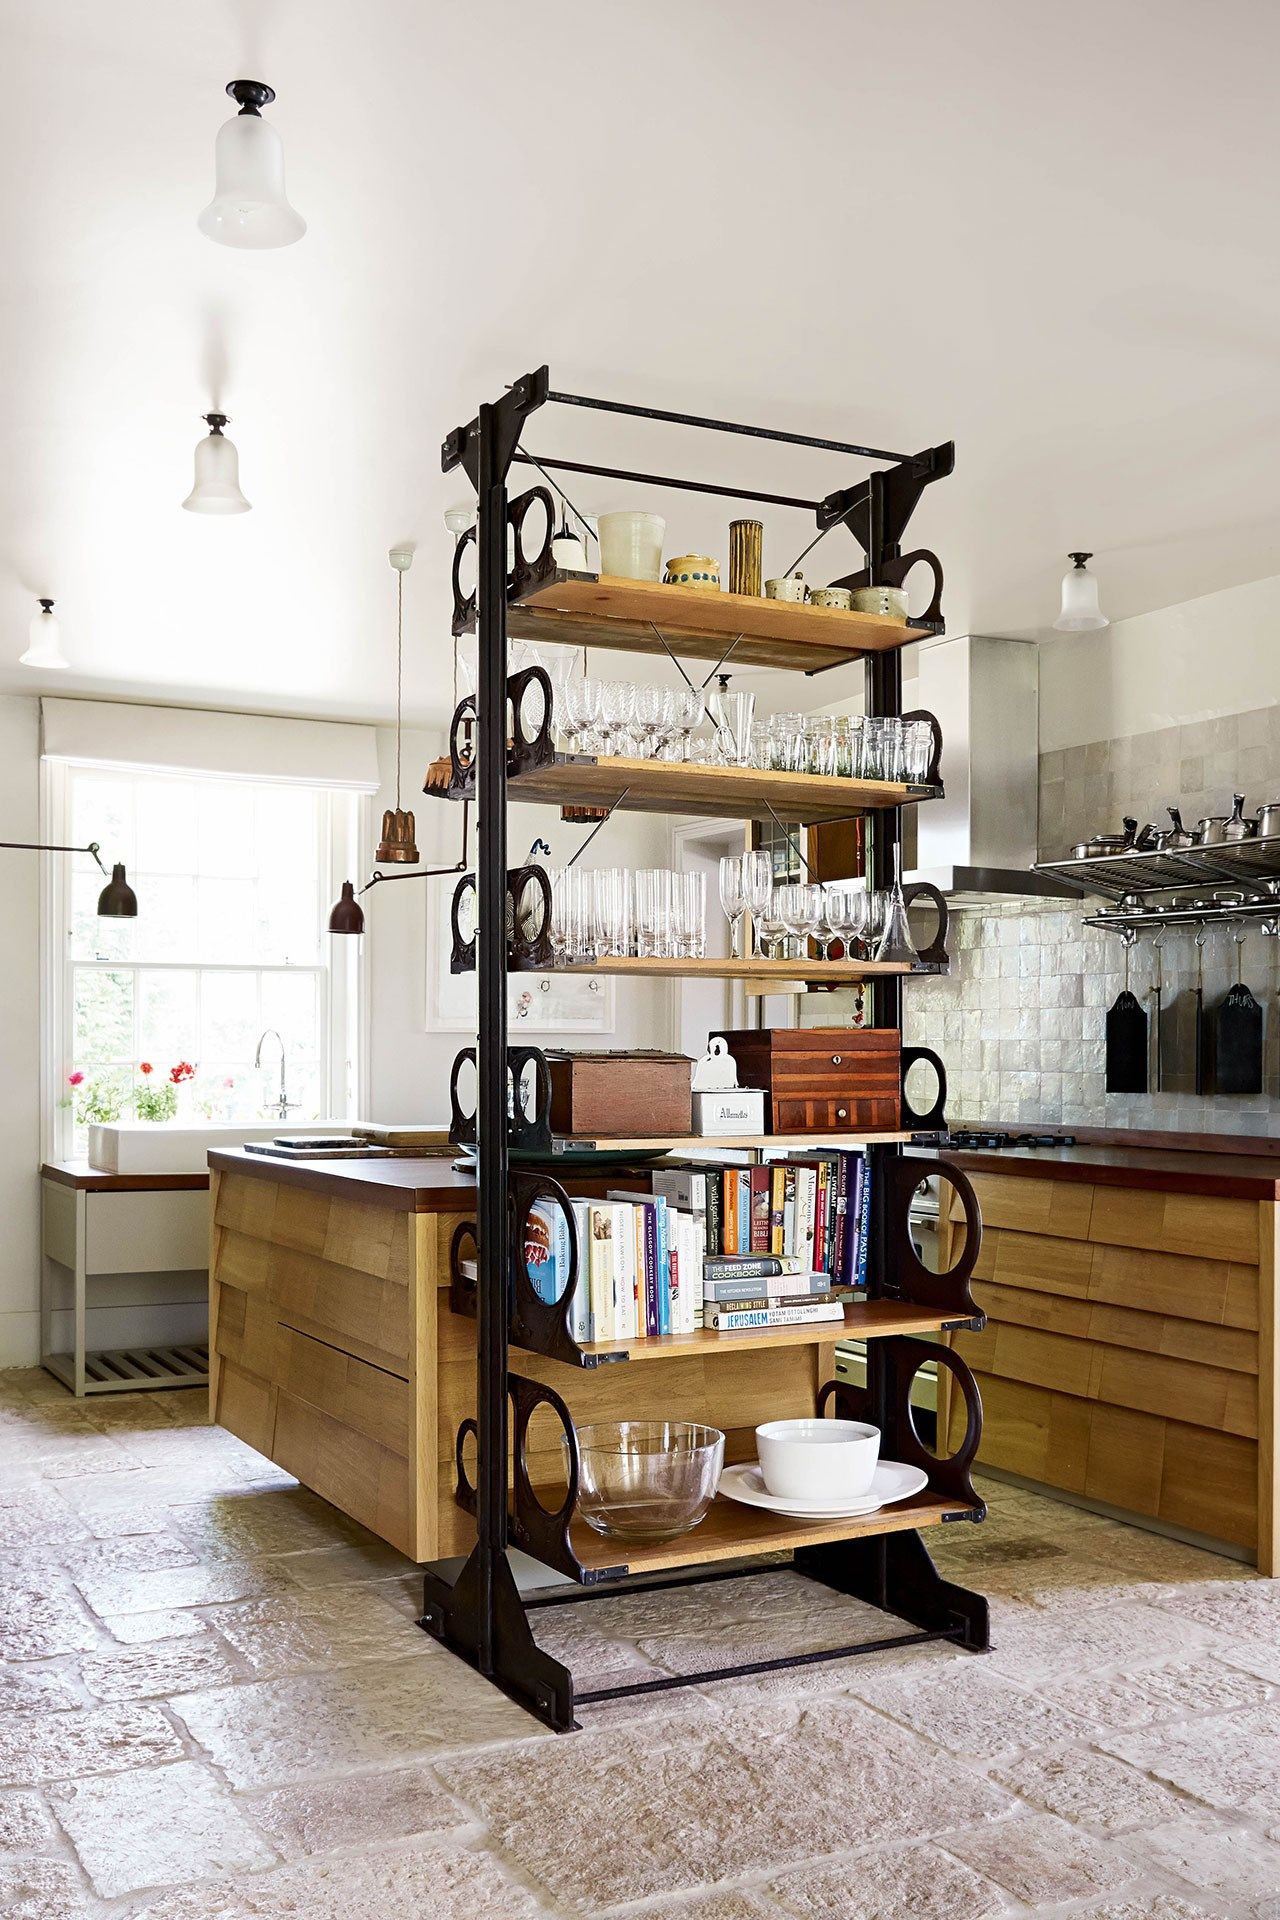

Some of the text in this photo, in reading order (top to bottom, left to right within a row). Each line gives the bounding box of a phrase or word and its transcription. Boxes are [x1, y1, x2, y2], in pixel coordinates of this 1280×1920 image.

[830, 1176, 838, 1208] LIVEBAIT
[840, 1174, 848, 1196] OLIVER
[710, 1185, 718, 1205] wild
[806, 1175, 815, 1225] Mushrooms
[862, 1187, 870, 1203] BIG
[558, 1222, 566, 1240] Bible
[660, 1228, 668, 1248] Made
[558, 1242, 566, 1268] Baking
[660, 1250, 668, 1266] Easy
[860, 1236, 868, 1264] PASTA
[712, 1270, 762, 1280] COOKBOOK
[724, 1264, 742, 1272] FEED
[742, 1262, 762, 1270] ZONE
[753, 1300, 766, 1308] STYLE
[727, 1312, 768, 1328] JERUSALEM
[769, 1310, 786, 1318] YOTAM
